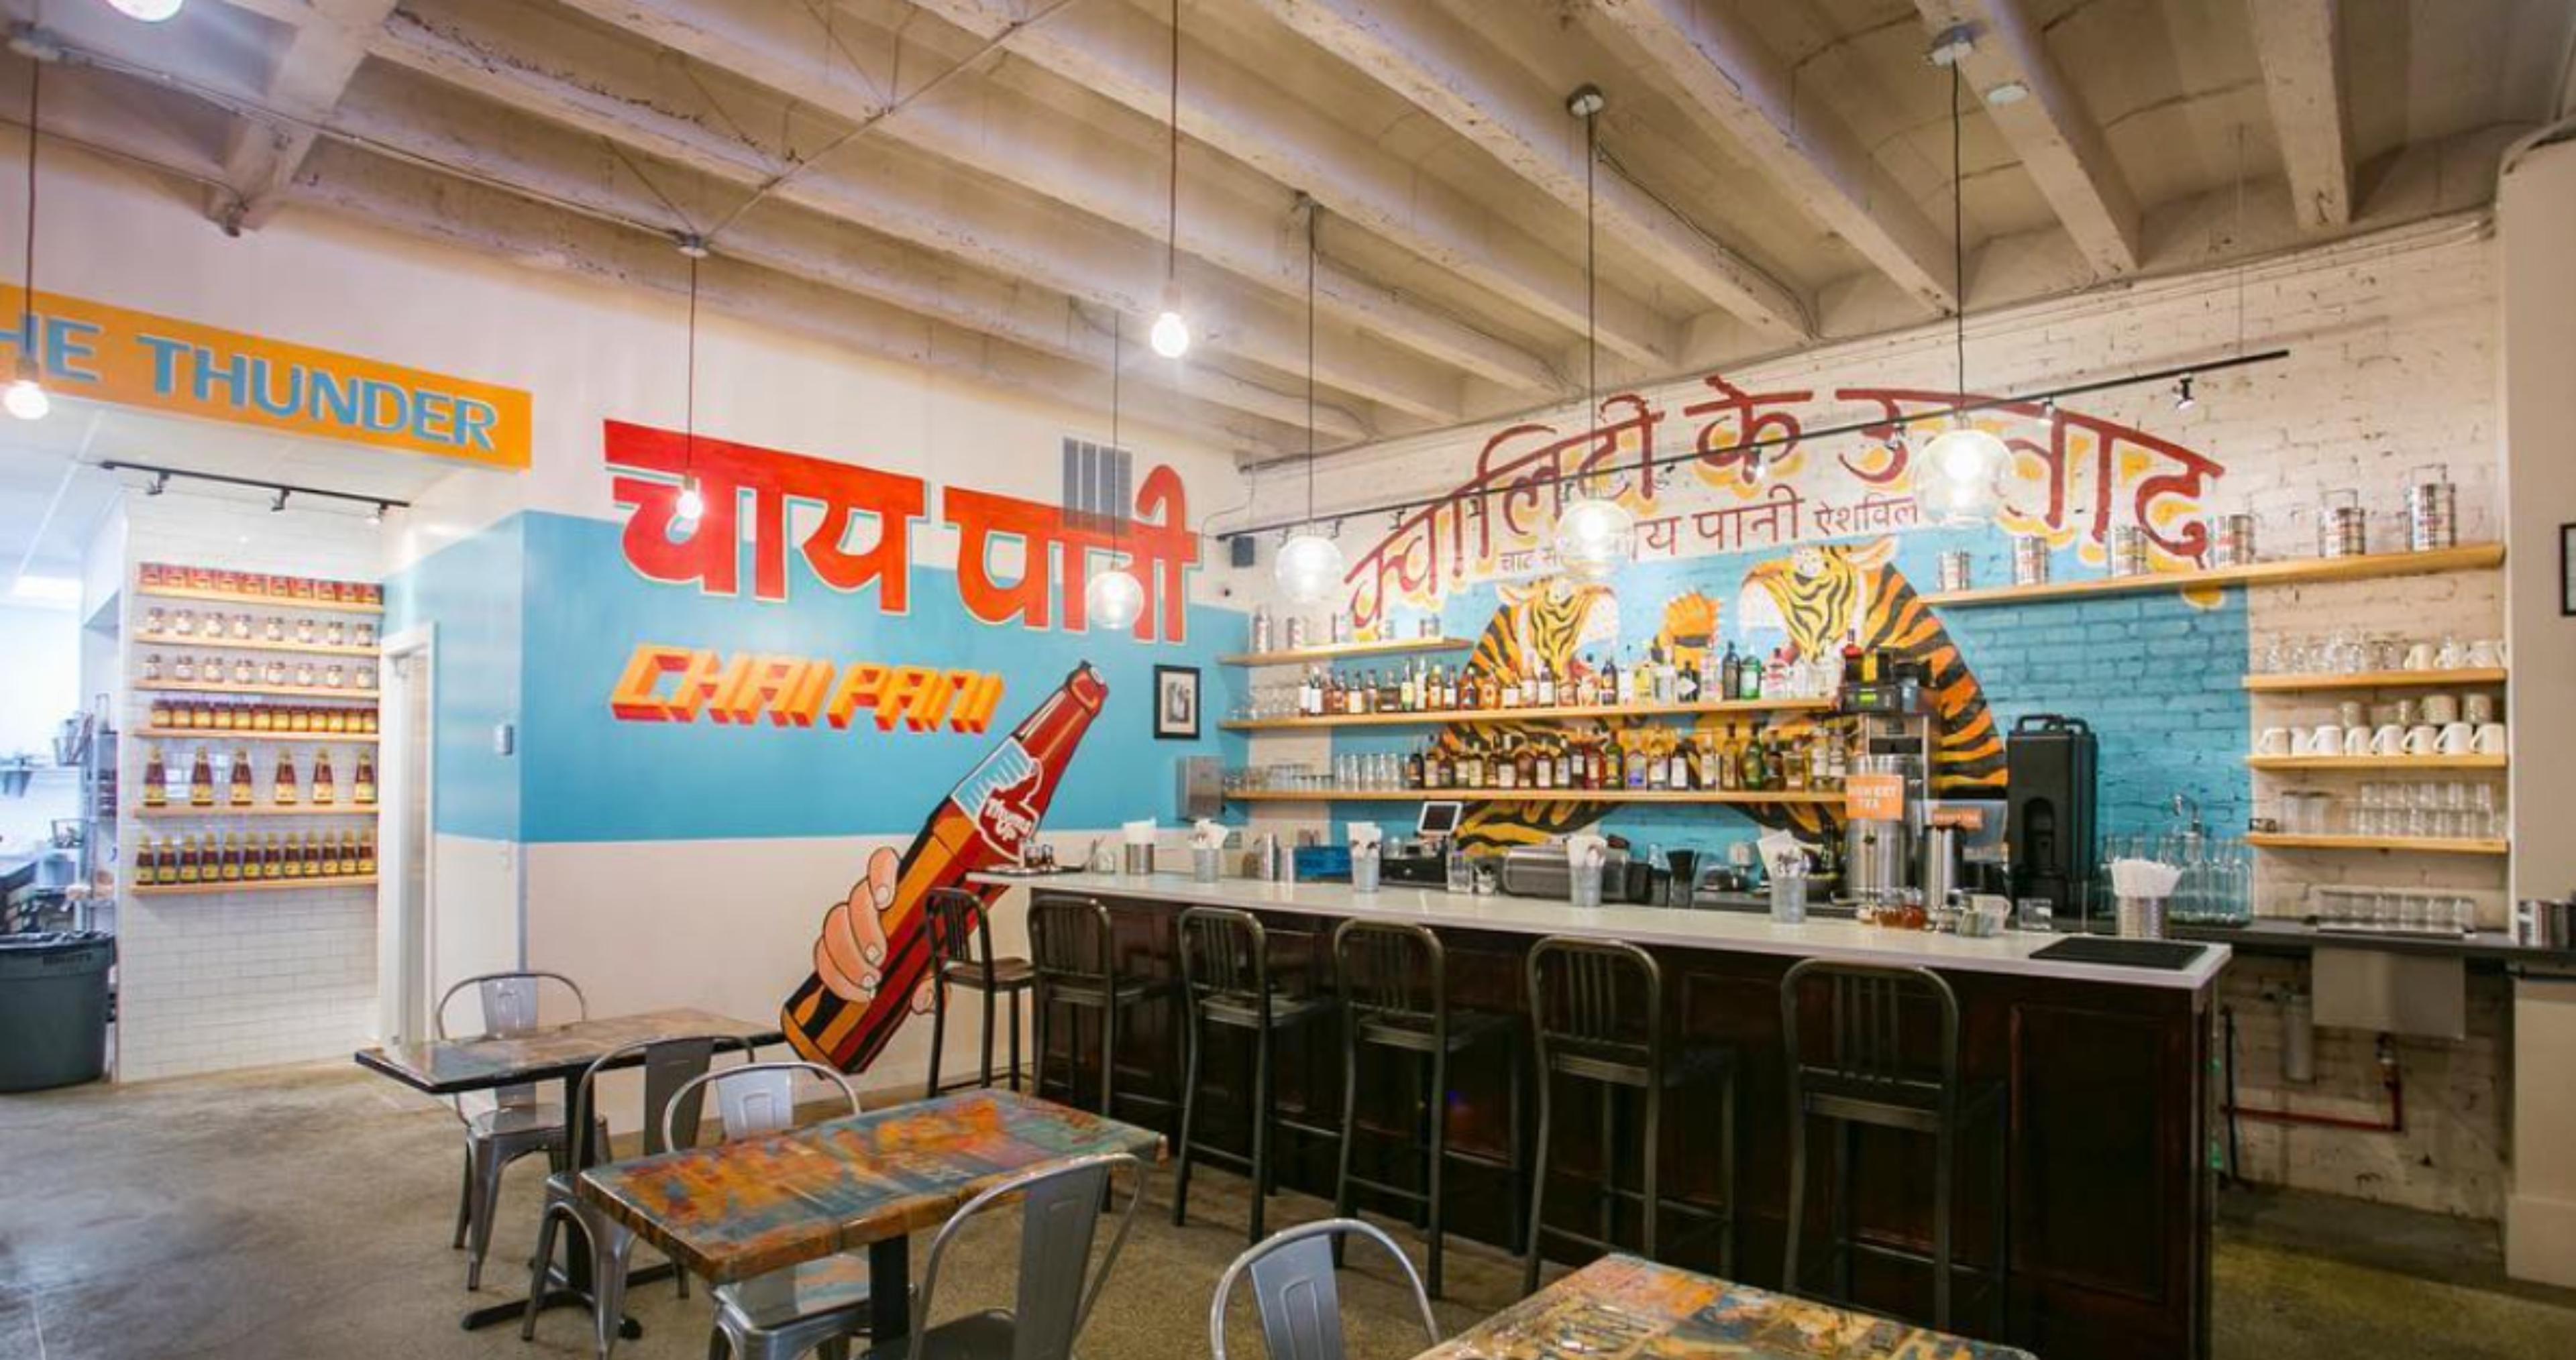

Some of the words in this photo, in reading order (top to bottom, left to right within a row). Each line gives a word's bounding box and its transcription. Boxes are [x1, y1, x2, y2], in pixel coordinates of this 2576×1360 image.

[135, 334, 497, 451] THUNDER
[1684, 376, 1814, 484] के
[604, 419, 926, 614] चाय
[944, 464, 1199, 644] पानी
[1691, 484, 1805, 550] पानी
[610, 642, 835, 727] CHAI
[827, 661, 1004, 734] PANI
